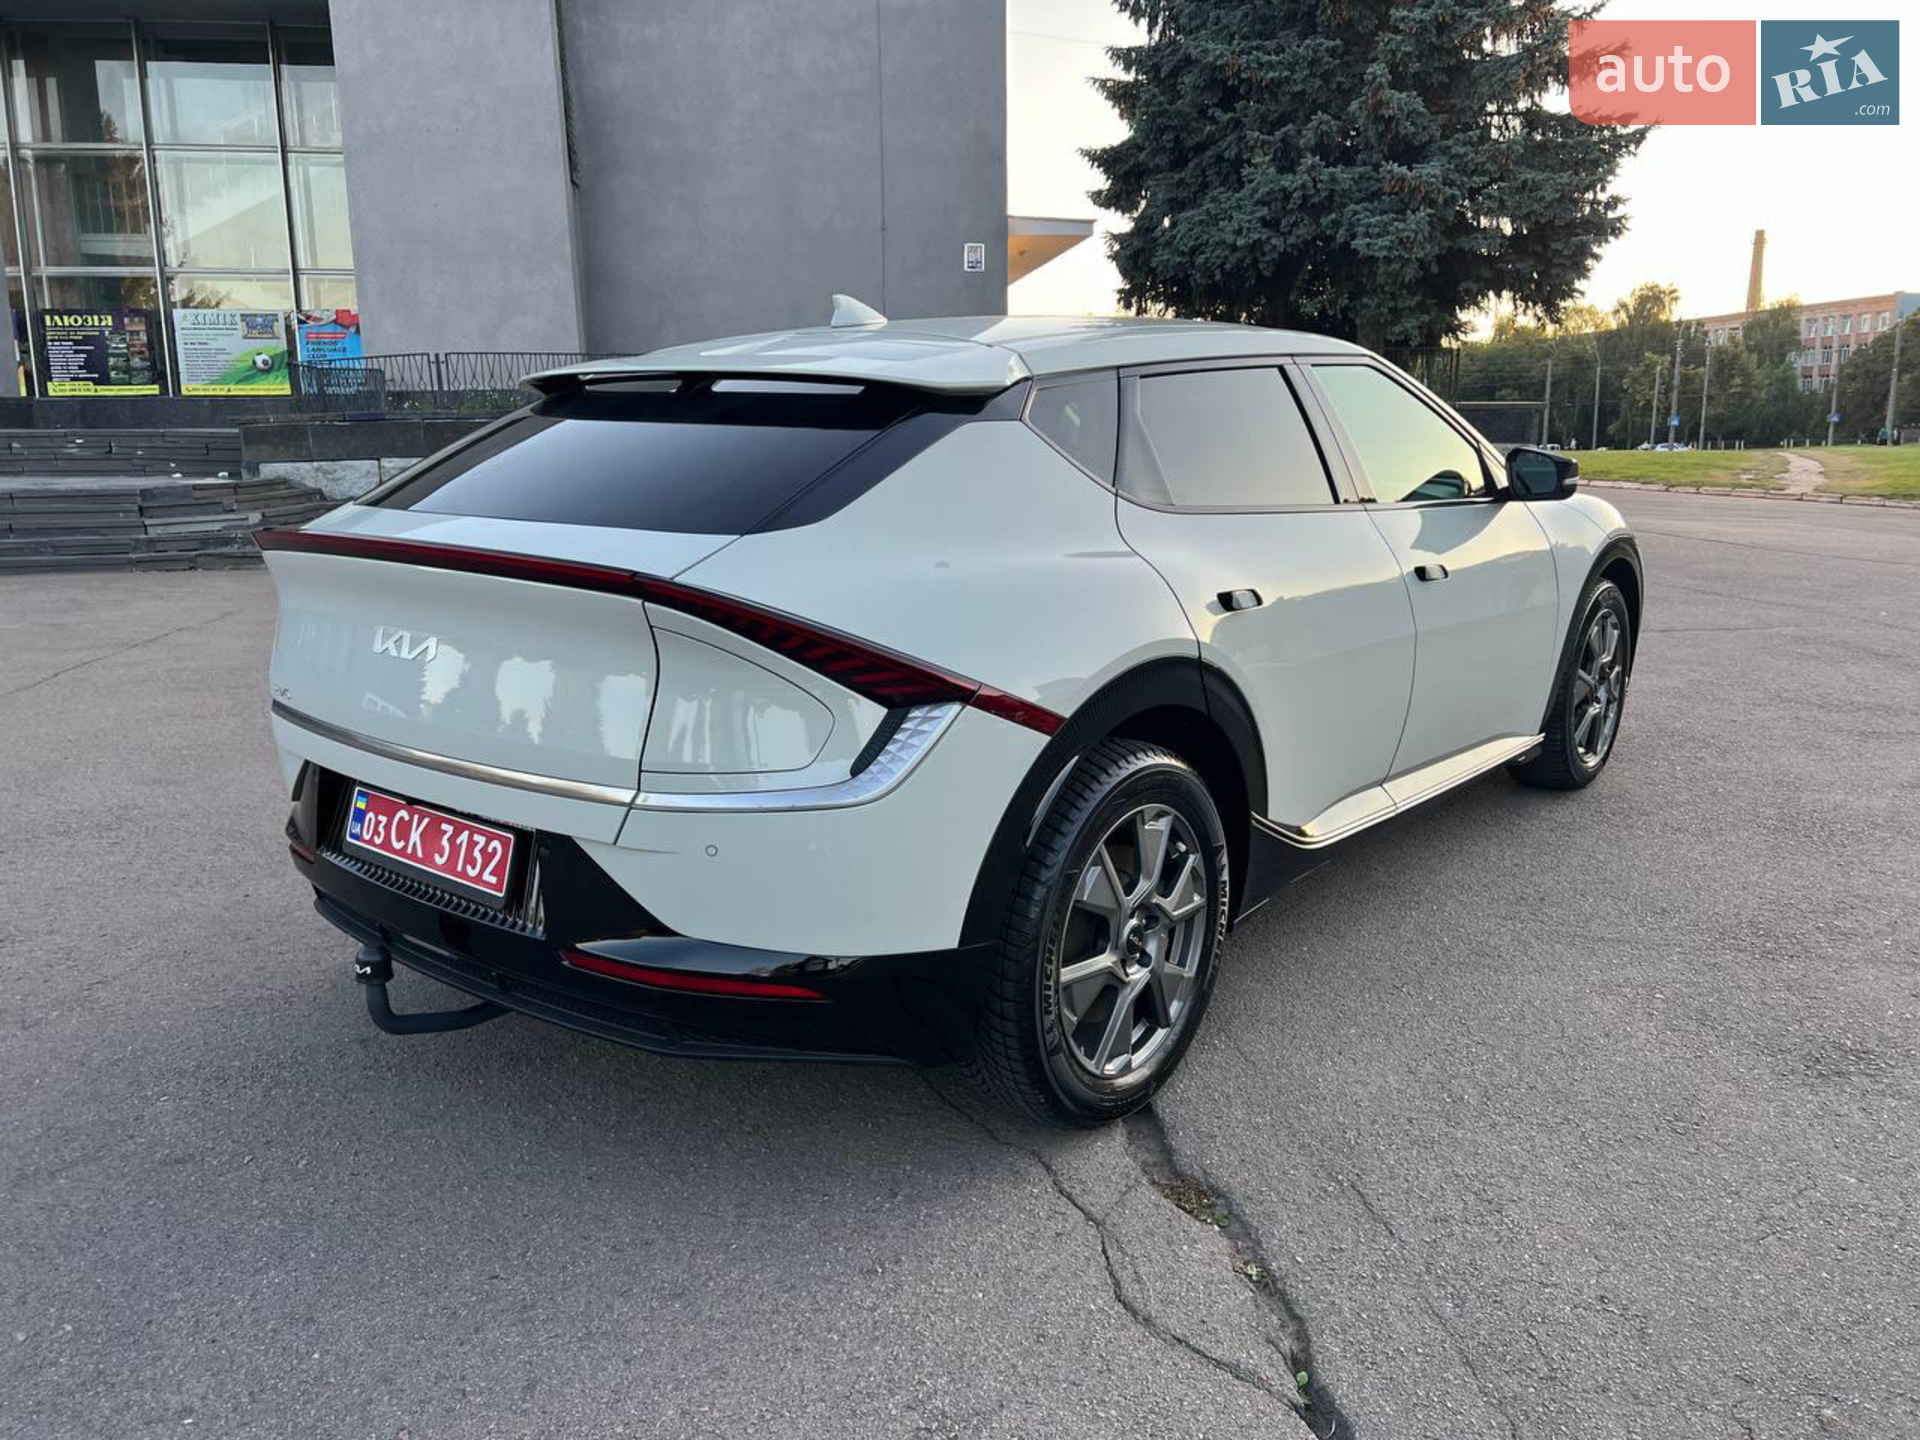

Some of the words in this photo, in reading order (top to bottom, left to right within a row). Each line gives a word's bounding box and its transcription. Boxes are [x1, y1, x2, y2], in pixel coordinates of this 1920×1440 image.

[45, 314, 113, 327] ІЛЮЗІЯ
[373, 625, 438, 662] KIA
[351, 821, 361, 835] UA
[363, 812, 387, 845] 03
[391, 809, 430, 858] CK
[434, 823, 503, 884] 3132
